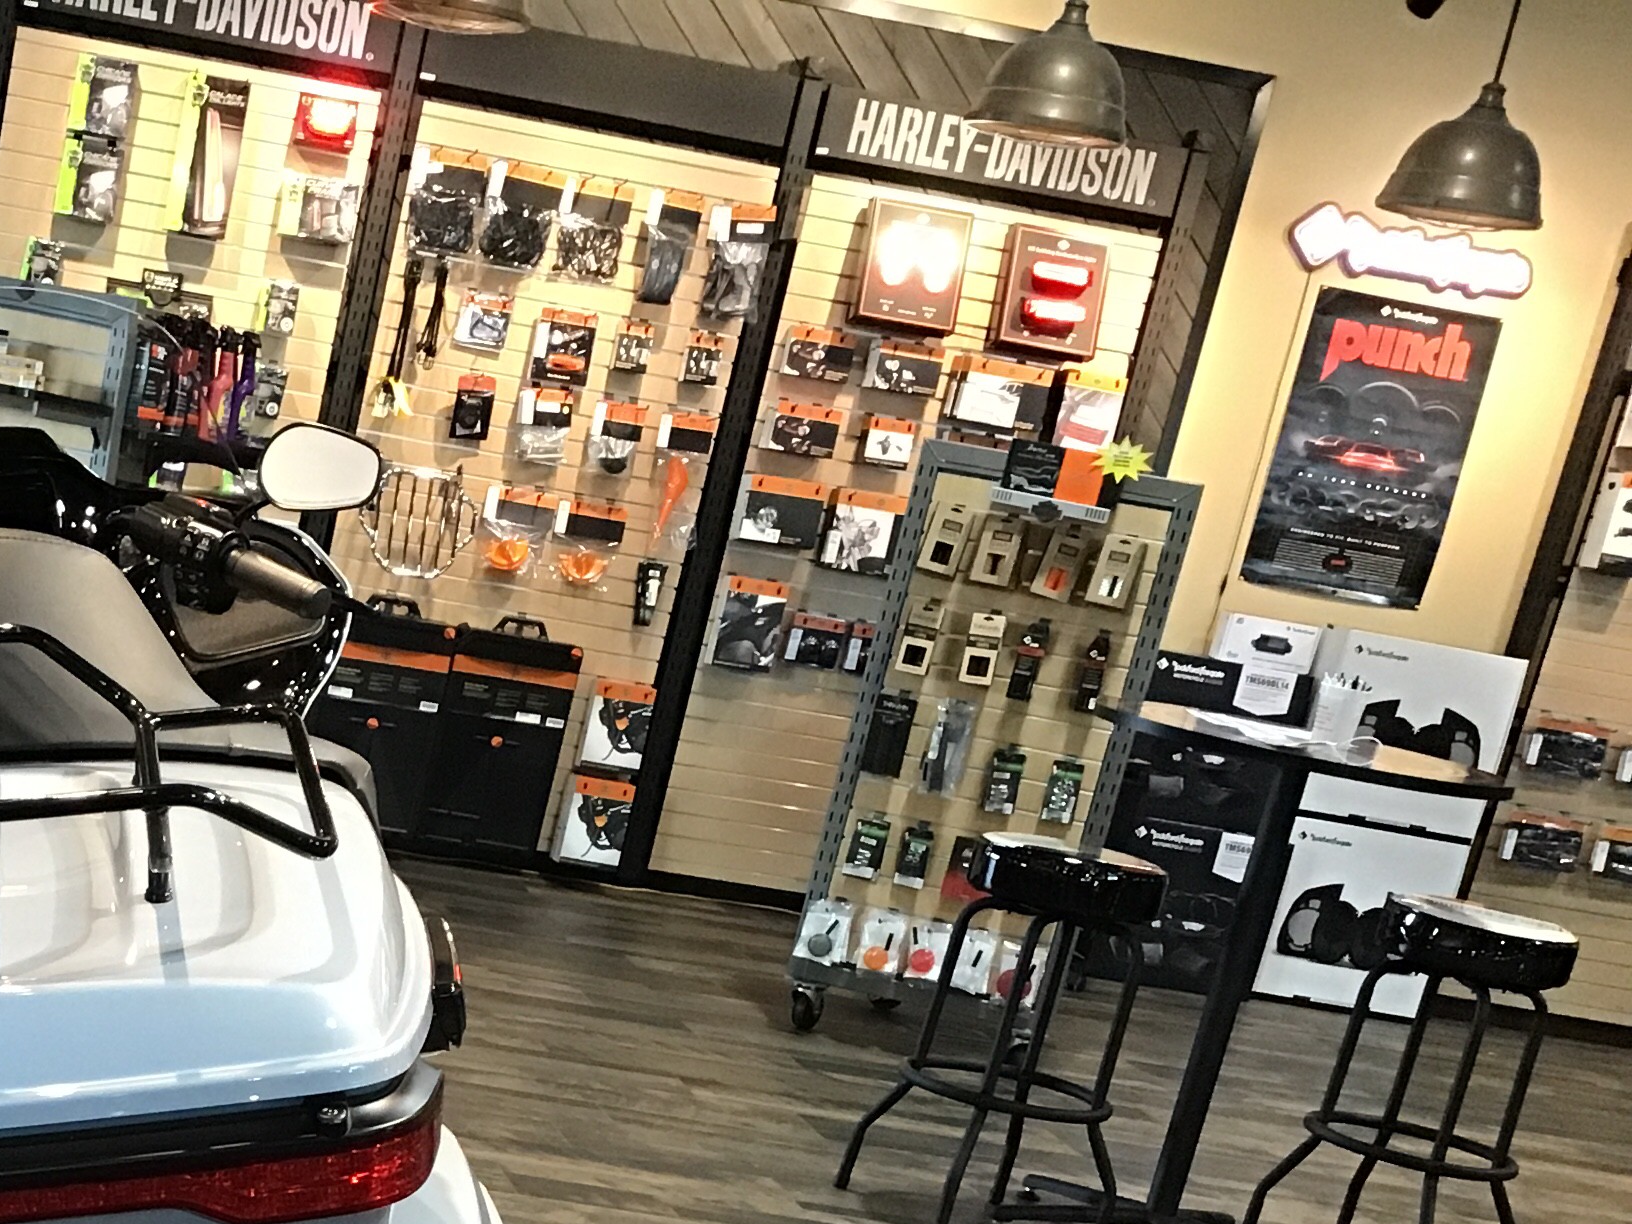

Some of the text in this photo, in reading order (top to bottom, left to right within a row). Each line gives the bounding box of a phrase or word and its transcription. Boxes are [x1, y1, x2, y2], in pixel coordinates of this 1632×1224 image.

[51, 0, 368, 60] -DAVIDSON
[846, 98, 1157, 205] HARLEY-DAVIDSON
[1319, 317, 1472, 382] punch
